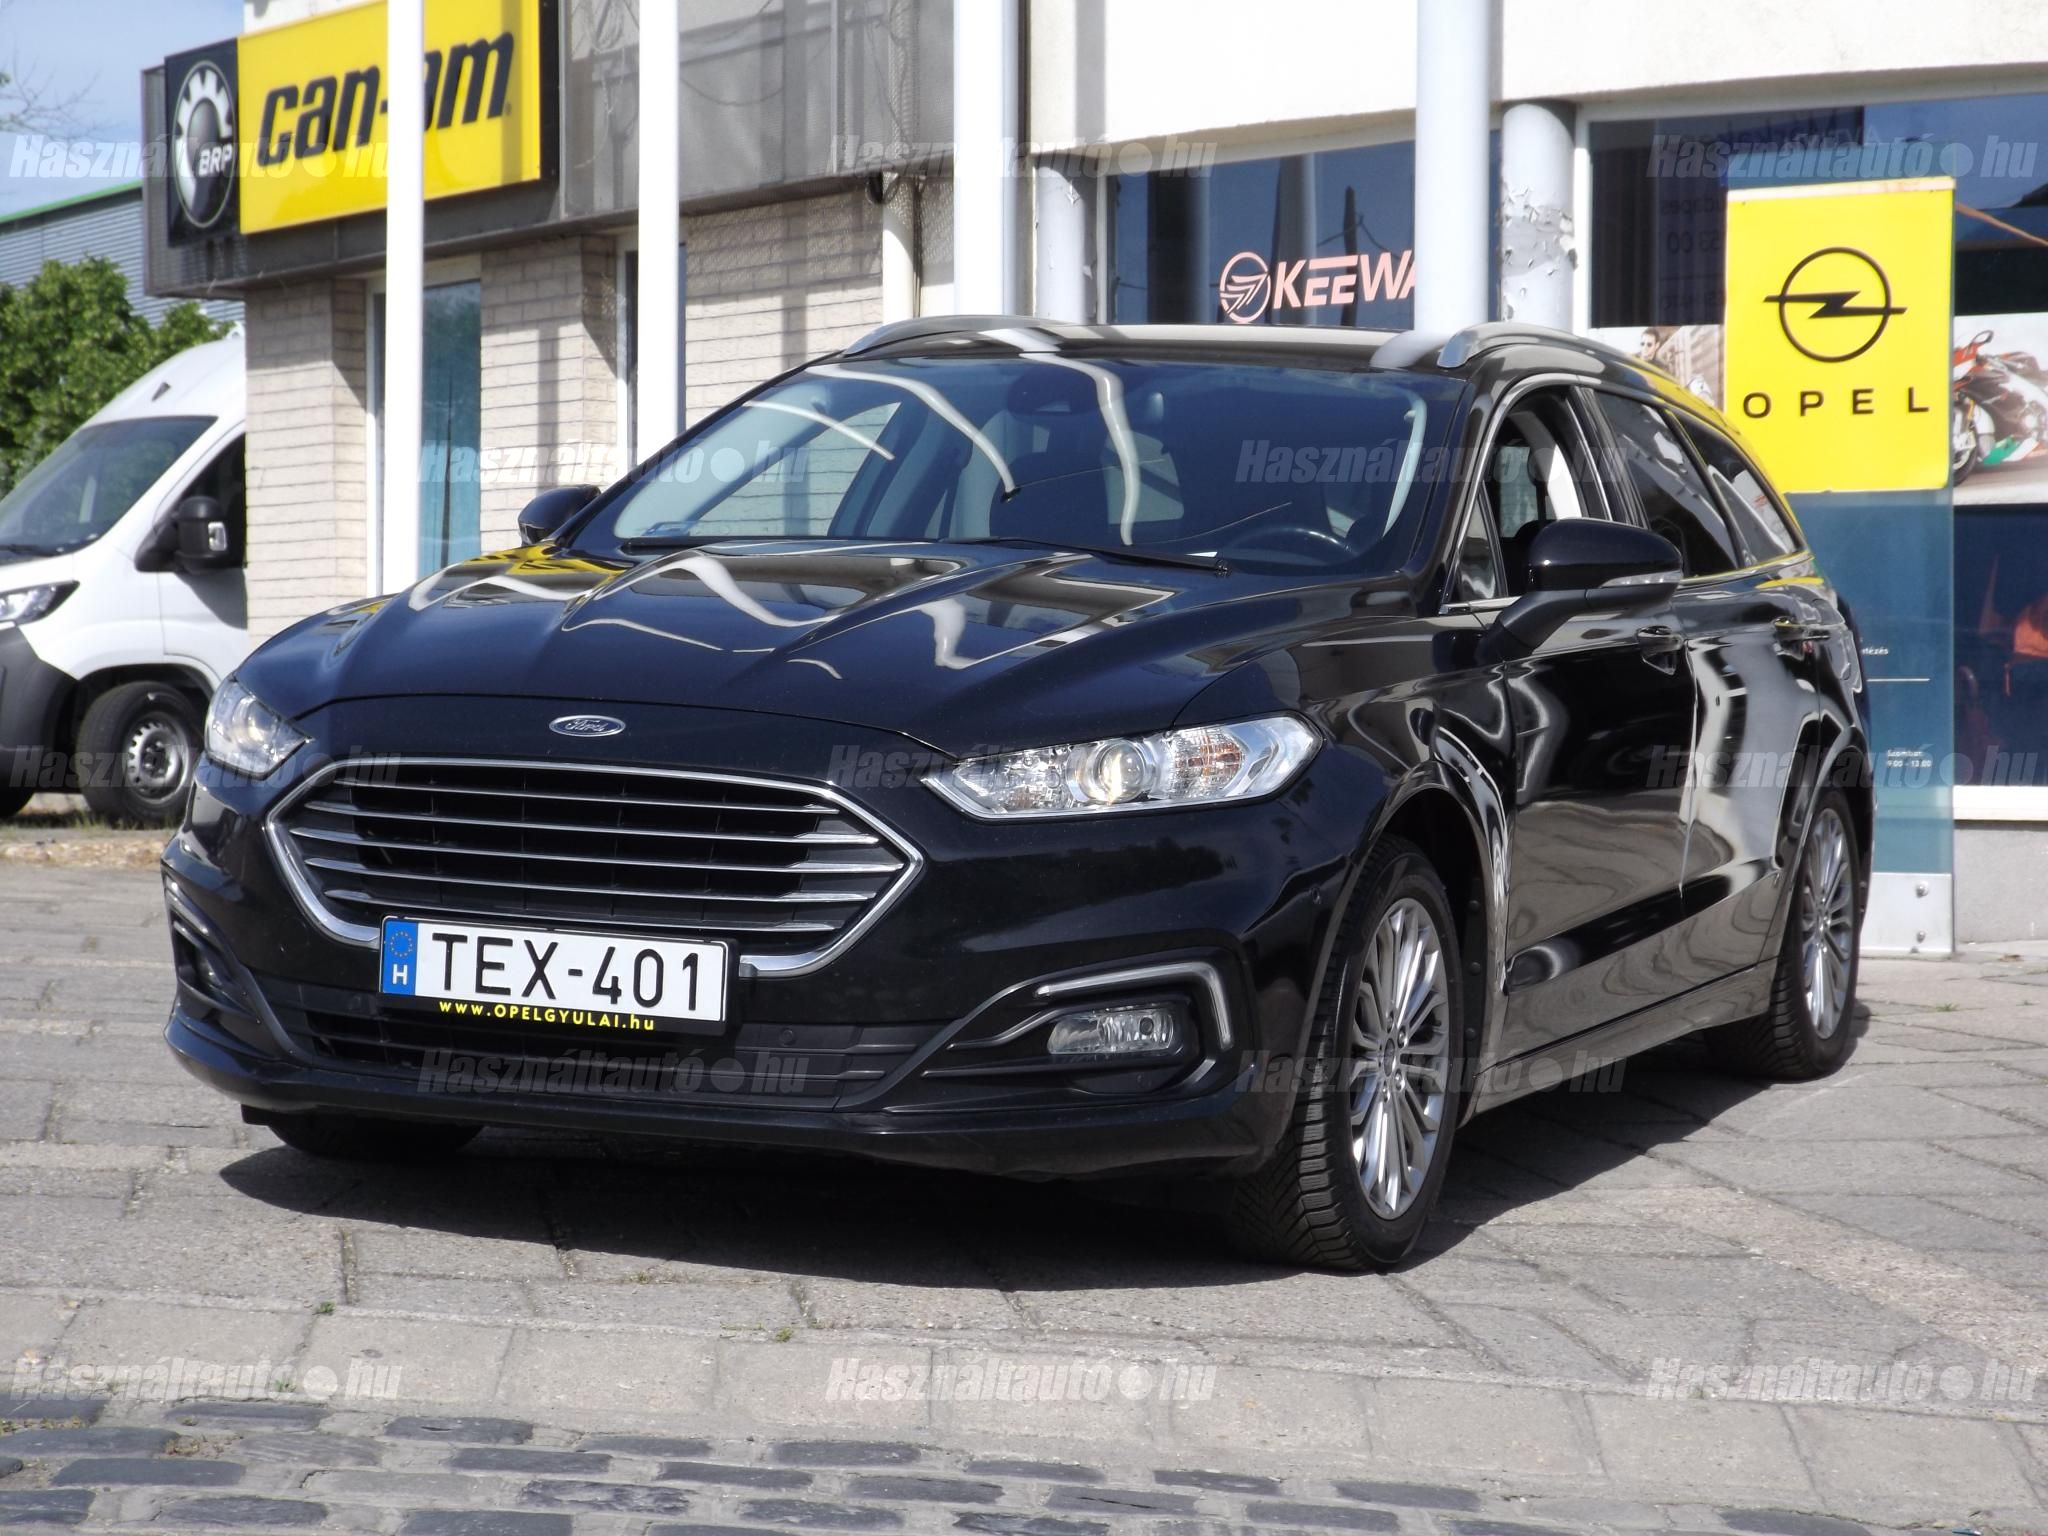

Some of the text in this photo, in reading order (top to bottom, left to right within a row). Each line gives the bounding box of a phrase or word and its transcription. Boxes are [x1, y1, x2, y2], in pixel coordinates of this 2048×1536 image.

[199, 144, 234, 176] BRP
[1743, 387, 1930, 419] OPEL
[564, 718, 609, 733] Ford
[392, 964, 408, 985] H
[432, 932, 700, 1012] TEX-401
[438, 1001, 656, 1031] www.OPELGYULAI.hu
